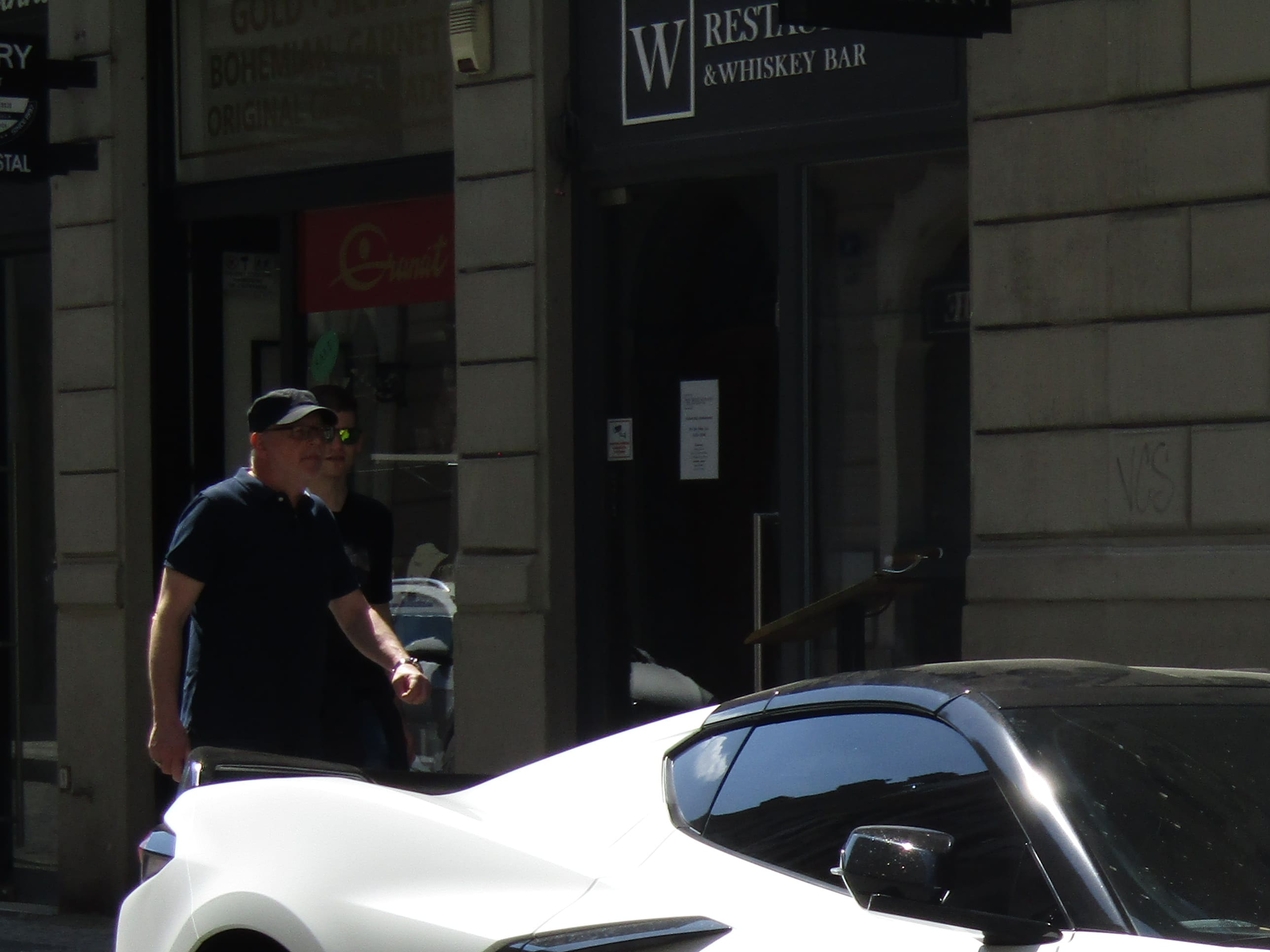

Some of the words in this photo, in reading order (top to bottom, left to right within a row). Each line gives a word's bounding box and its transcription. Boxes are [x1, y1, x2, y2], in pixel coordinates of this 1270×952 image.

[629, 19, 687, 92] W
[704, 50, 817, 87] &WHISKEY
[824, 43, 867, 71] BAR
